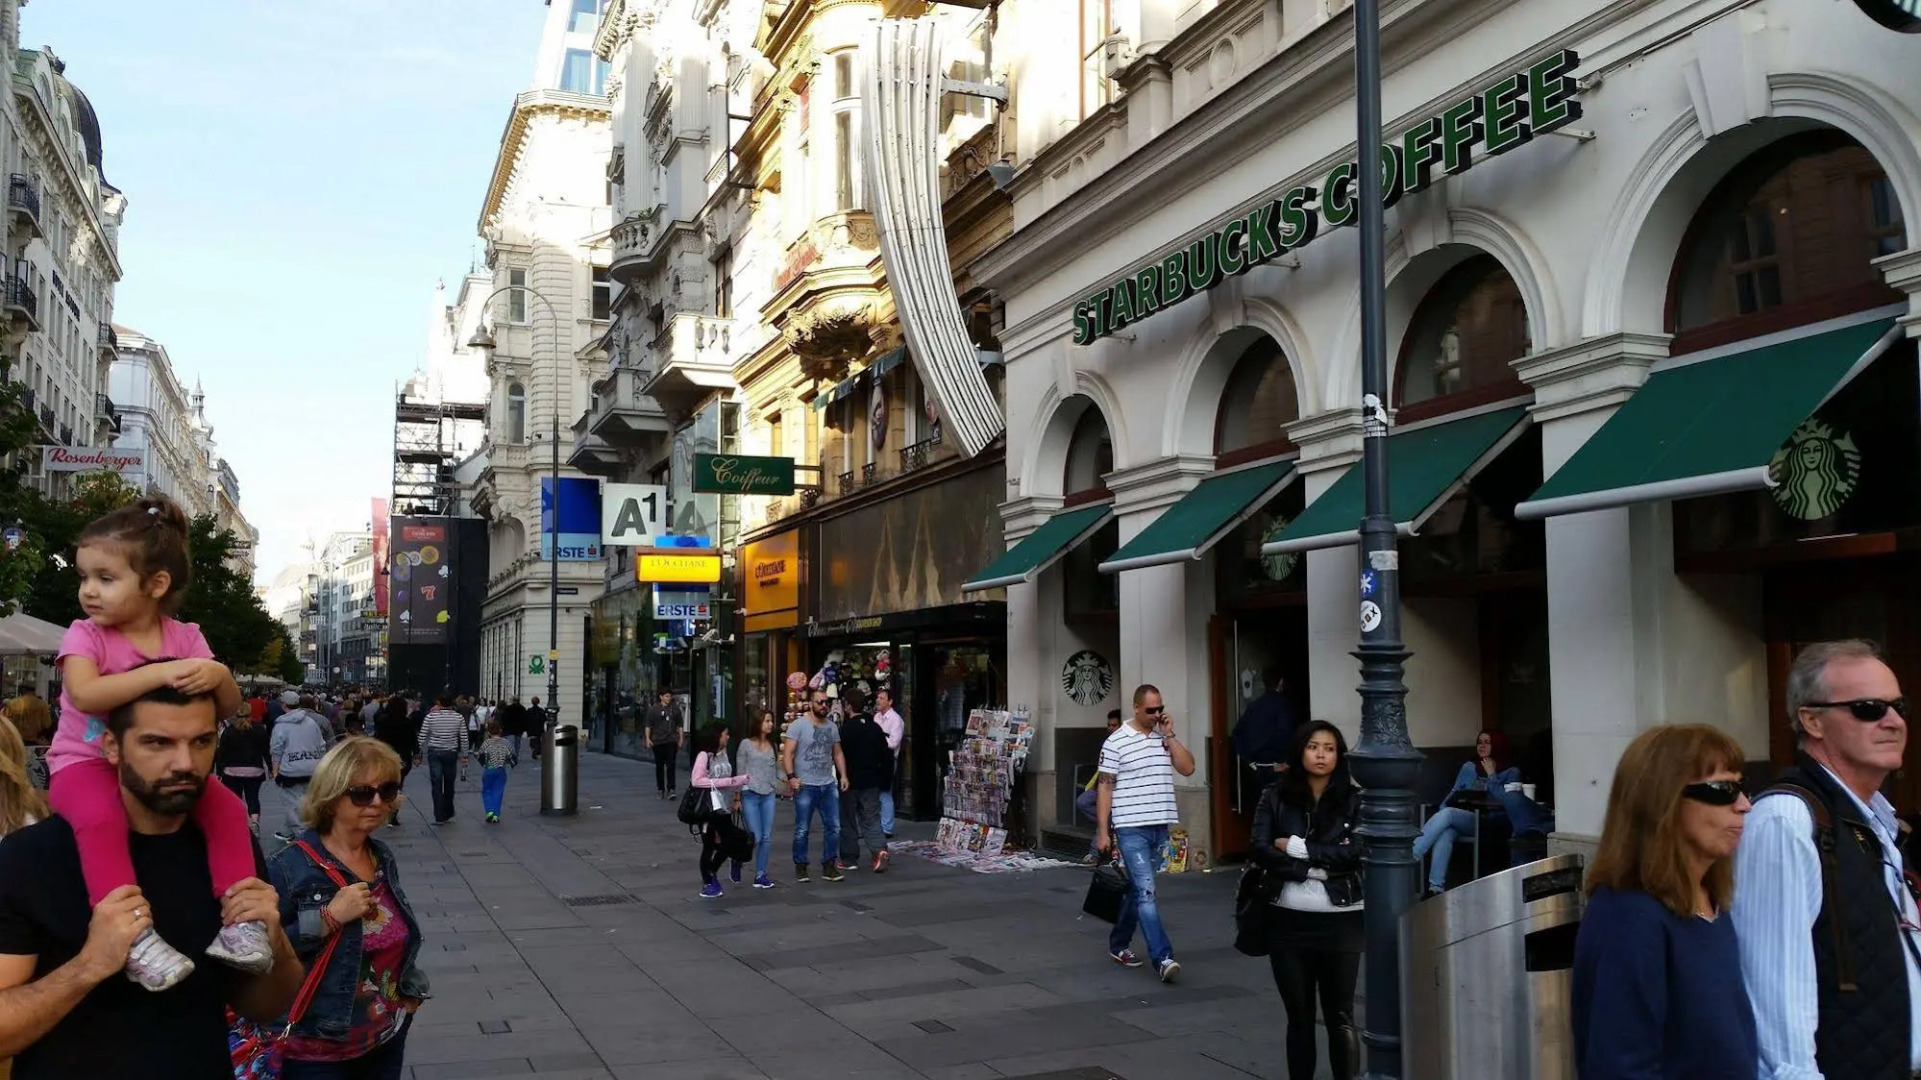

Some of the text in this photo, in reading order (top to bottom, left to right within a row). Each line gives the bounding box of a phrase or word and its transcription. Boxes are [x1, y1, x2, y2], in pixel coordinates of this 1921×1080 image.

[1072, 186, 1315, 345] STARBUCKS
[48, 447, 142, 469] Rosenberger
[710, 457, 780, 491] Coiffeur
[611, 492, 657, 537] A1
[657, 605, 695, 616] ERSTE
